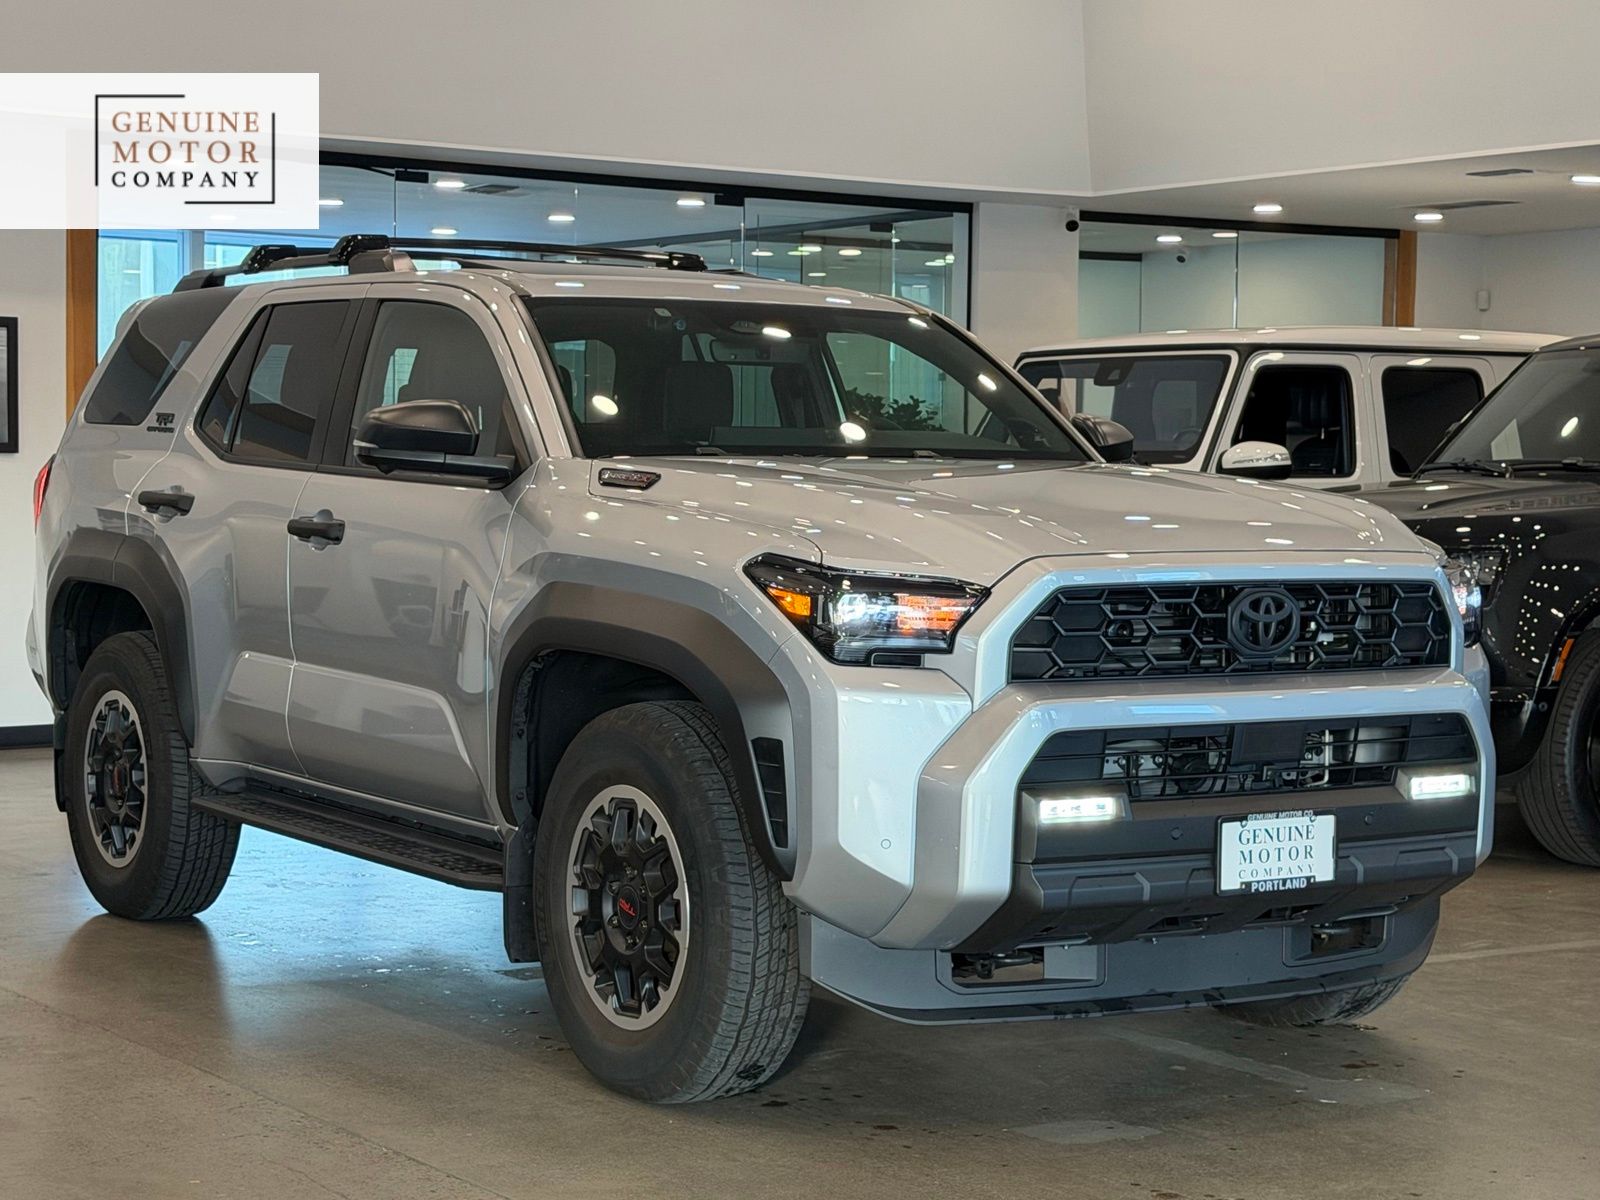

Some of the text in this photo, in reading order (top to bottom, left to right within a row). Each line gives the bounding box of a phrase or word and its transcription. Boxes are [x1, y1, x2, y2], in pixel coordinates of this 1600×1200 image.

[1238, 824, 1315, 845] GENUINE
[1239, 845, 1313, 865] MOTOR
[1238, 864, 1314, 879] COMPANY
[1251, 877, 1307, 893] PORTLAND
